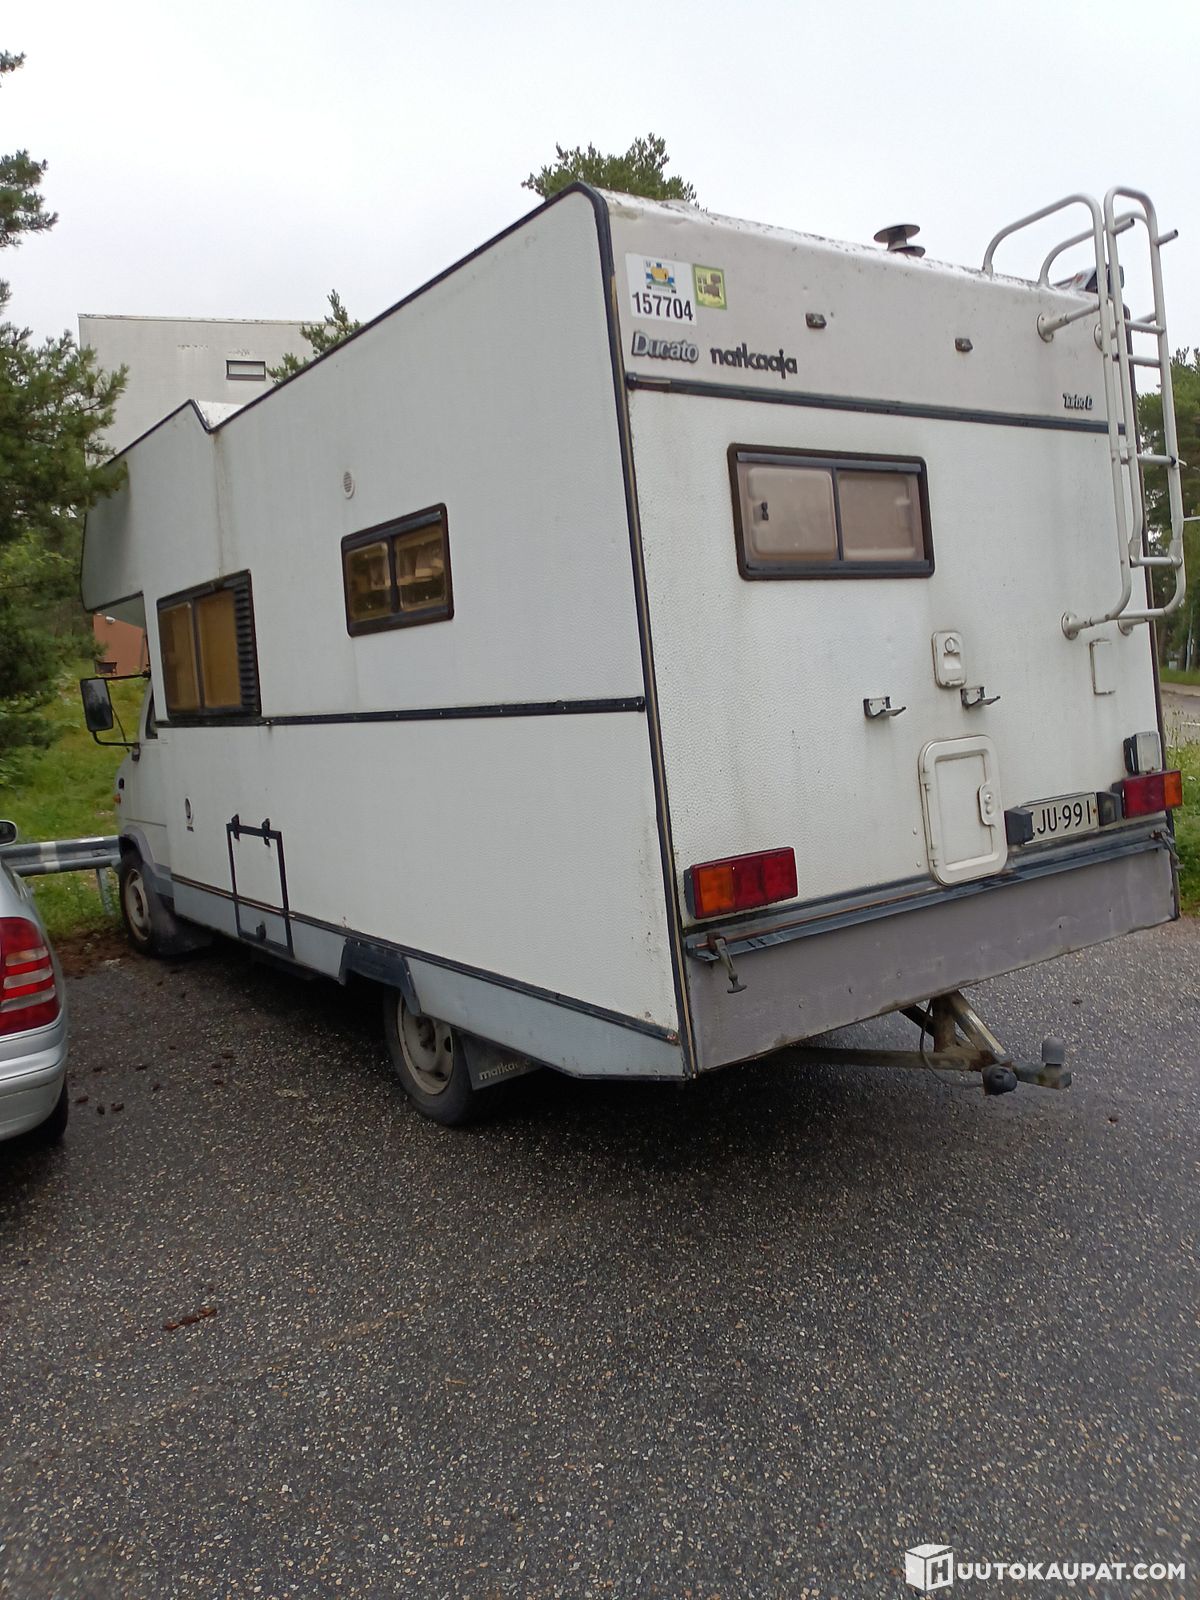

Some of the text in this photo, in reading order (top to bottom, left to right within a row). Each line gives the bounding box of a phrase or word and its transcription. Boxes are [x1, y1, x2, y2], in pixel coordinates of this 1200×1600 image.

[632, 292, 694, 321] 157704
[632, 331, 700, 364] Ducato
[1031, 800, 1091, 835] JU-991
